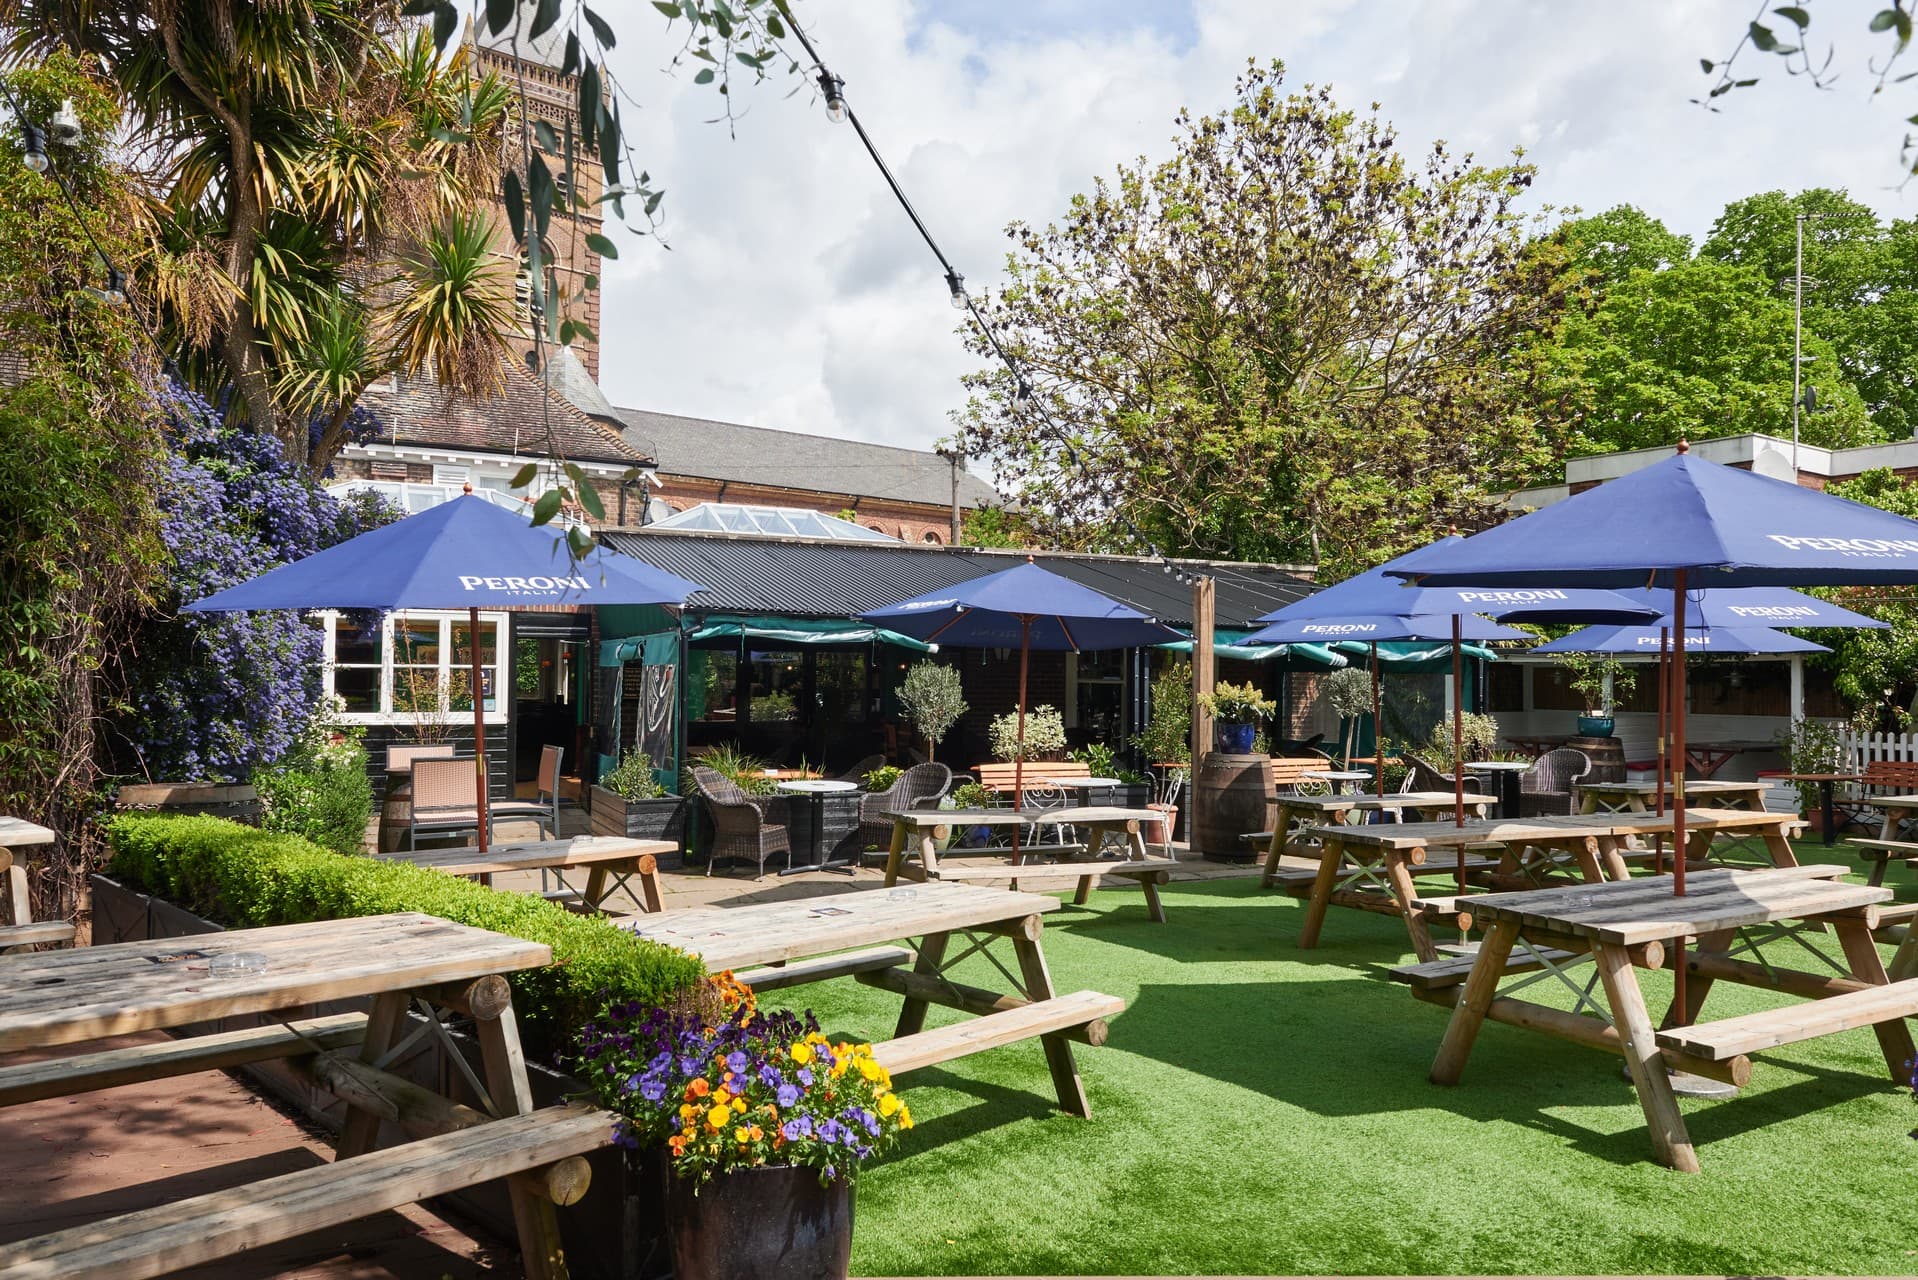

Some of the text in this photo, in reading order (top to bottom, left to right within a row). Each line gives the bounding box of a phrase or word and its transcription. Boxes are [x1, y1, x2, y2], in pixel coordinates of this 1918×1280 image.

[458, 576, 592, 591] PERONI
[1458, 590, 1568, 602] PERONI
[1727, 606, 1820, 617] PERONI
[1301, 624, 1377, 633] PERONI
[1637, 636, 1710, 645] PERNI
